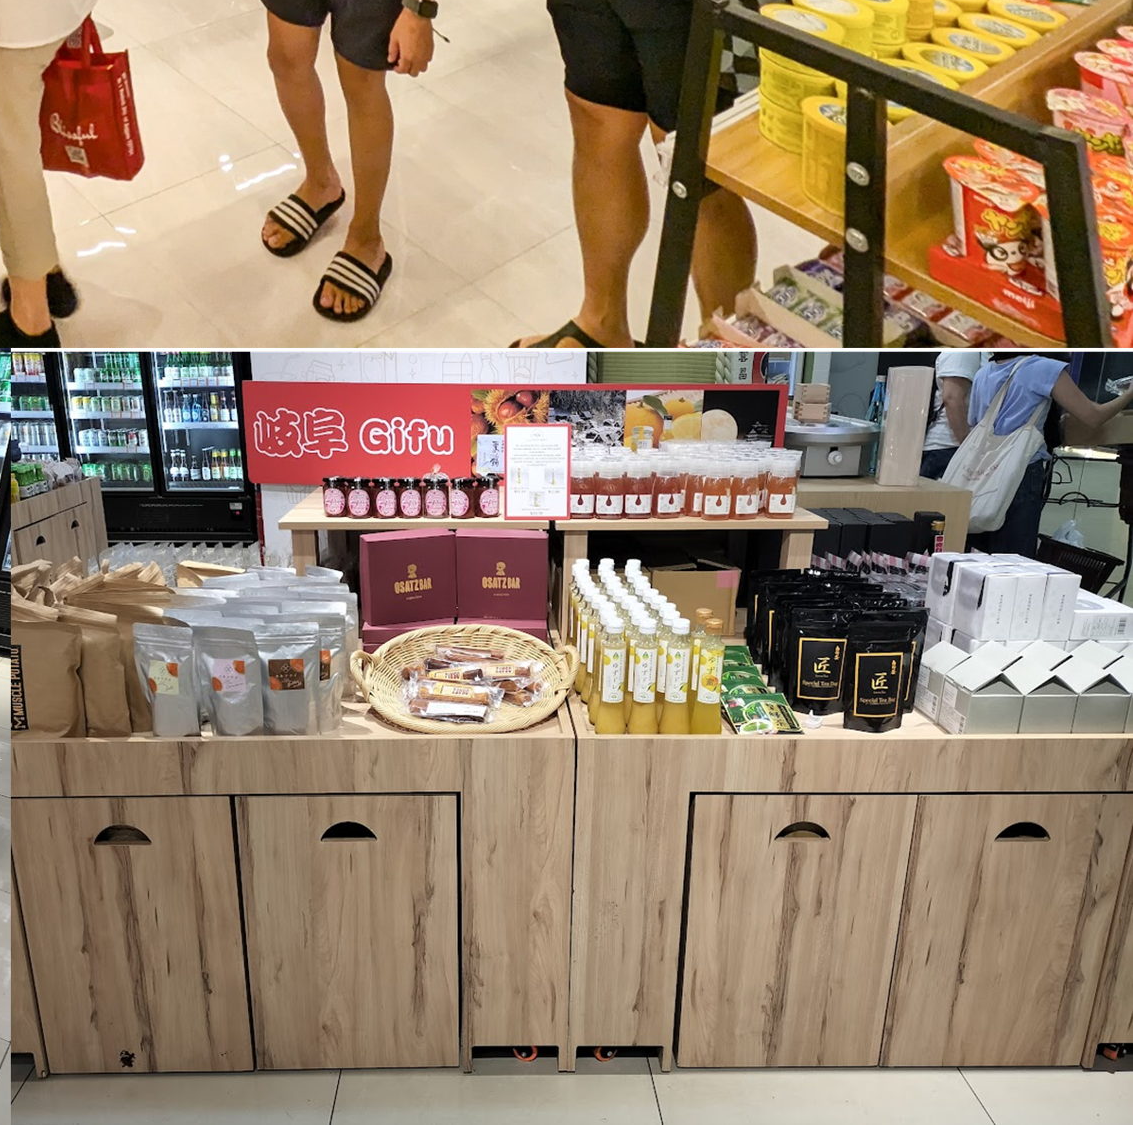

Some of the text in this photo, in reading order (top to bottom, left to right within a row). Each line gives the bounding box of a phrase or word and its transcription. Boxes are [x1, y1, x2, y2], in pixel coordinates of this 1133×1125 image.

[1002, 287, 1036, 311] meiji
[253, 407, 348, 459] 岐阜
[359, 415, 455, 456] Gifu
[813, 656, 832, 674] 匠
[870, 671, 889, 690] 匠
[11, 681, 24, 717] MUSCLE
